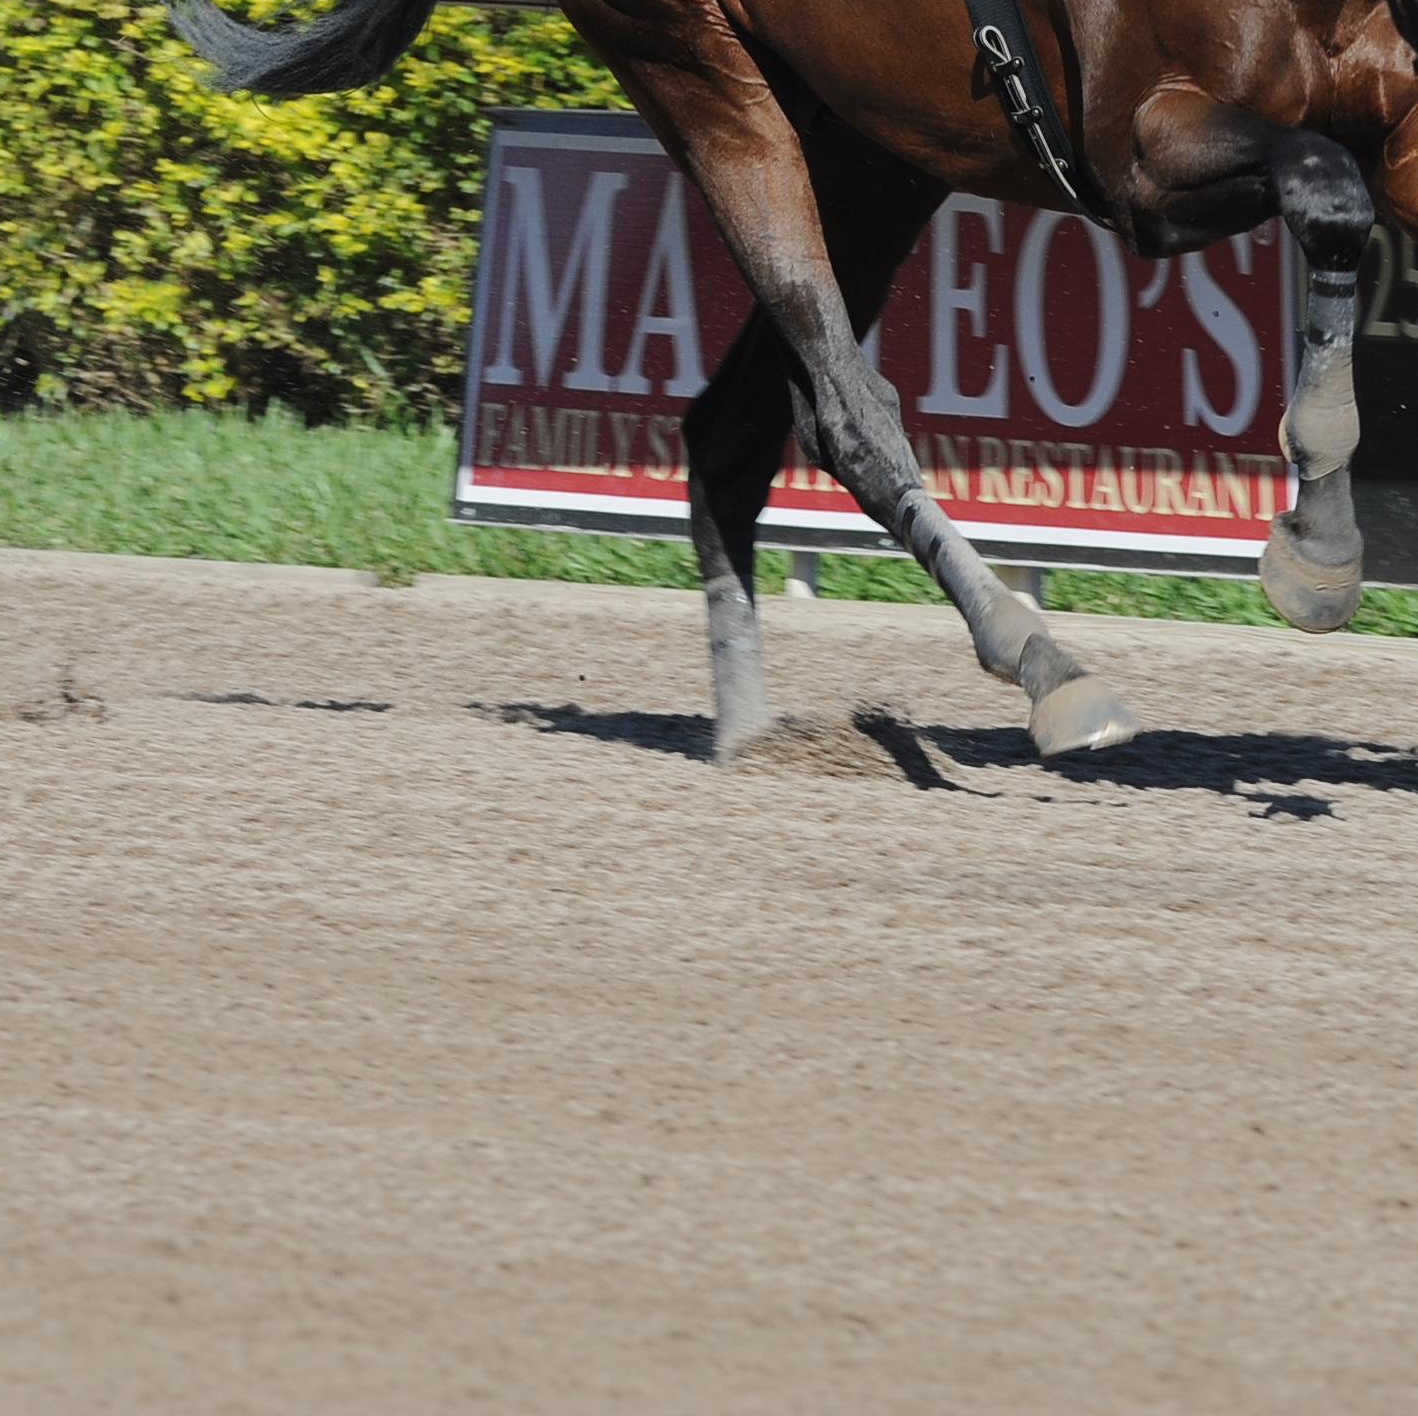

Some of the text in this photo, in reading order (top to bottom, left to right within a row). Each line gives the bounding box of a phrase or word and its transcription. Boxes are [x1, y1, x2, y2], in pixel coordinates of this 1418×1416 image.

[483, 166, 1262, 437] MAEO'S
[474, 402, 641, 477] FAMILY
[977, 436, 1281, 521] RESTAURANT
